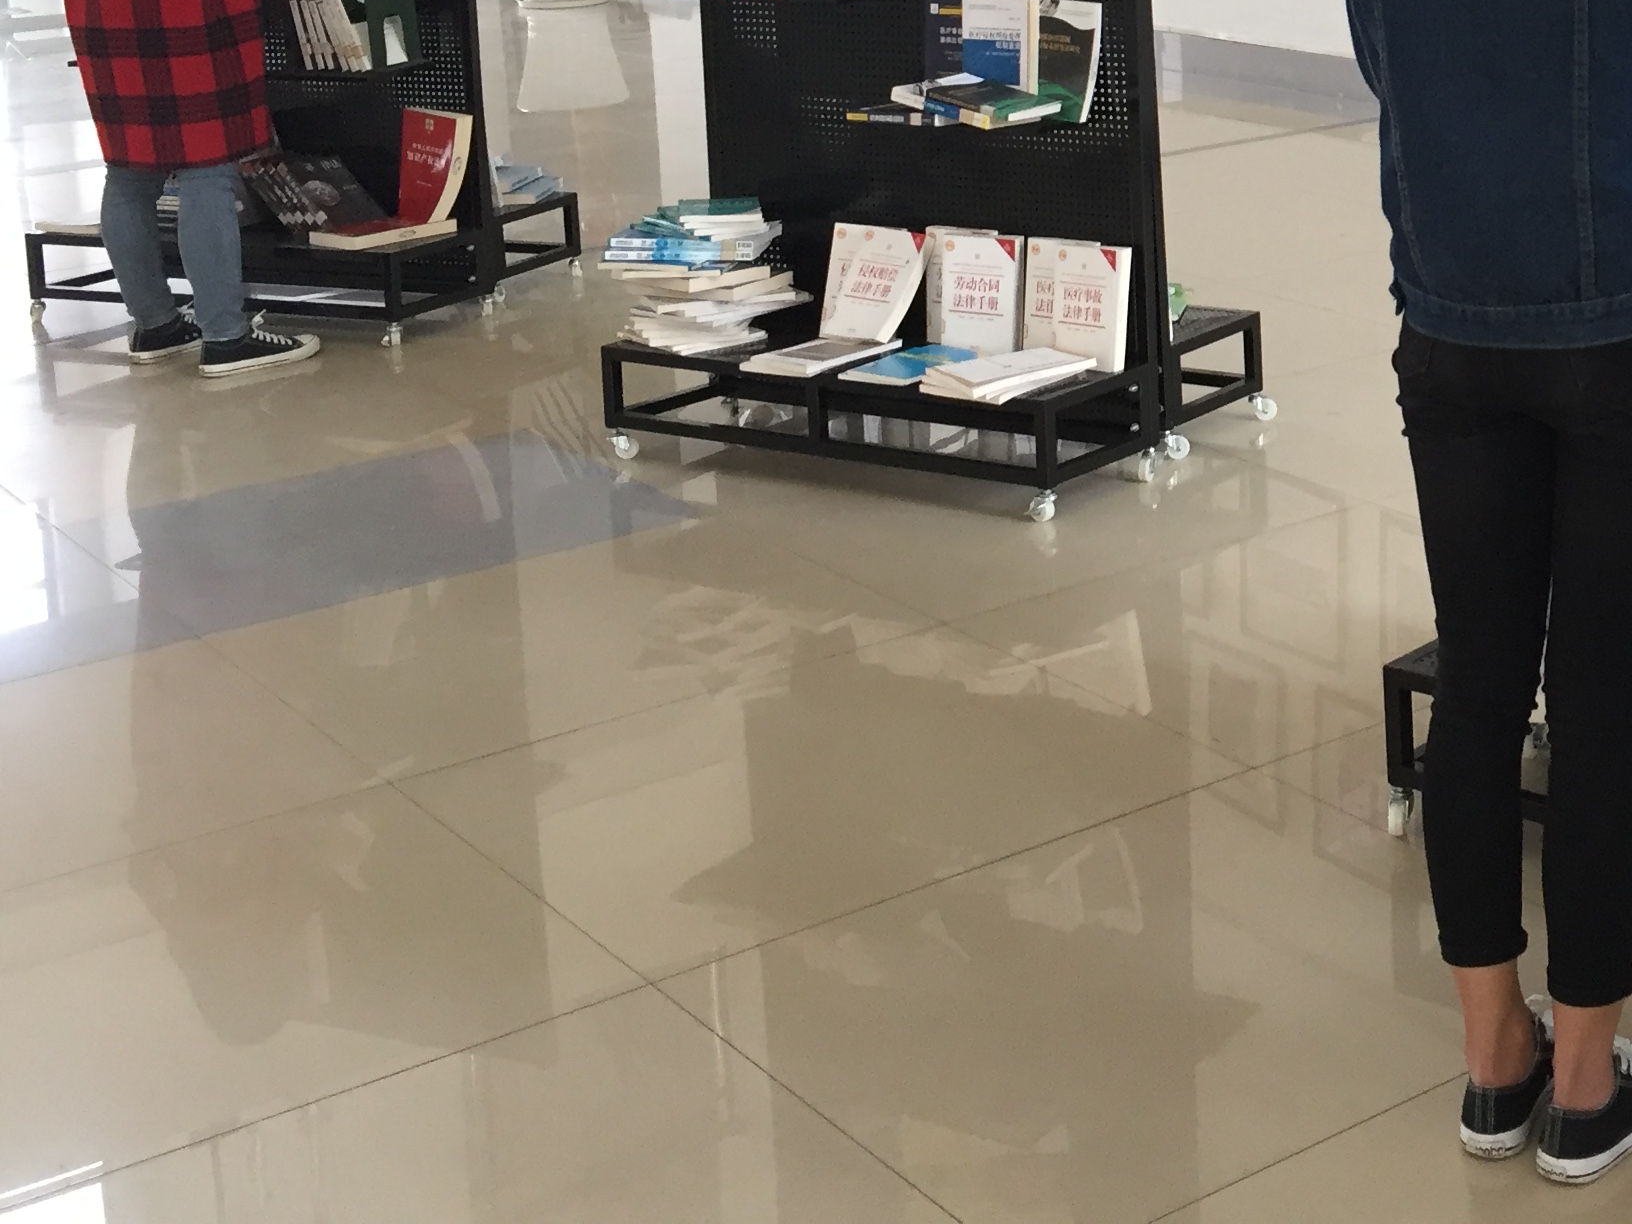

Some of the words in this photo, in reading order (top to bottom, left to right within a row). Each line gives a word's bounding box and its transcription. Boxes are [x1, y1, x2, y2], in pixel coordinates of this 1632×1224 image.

[858, 263, 899, 282] 侵权赔偿
[850, 280, 892, 298] 法律手册
[954, 276, 1000, 294] 劳动合同
[953, 293, 999, 312] 法律手册
[1063, 287, 1103, 304] 医疗事故
[1063, 304, 1102, 323] 法律手册
